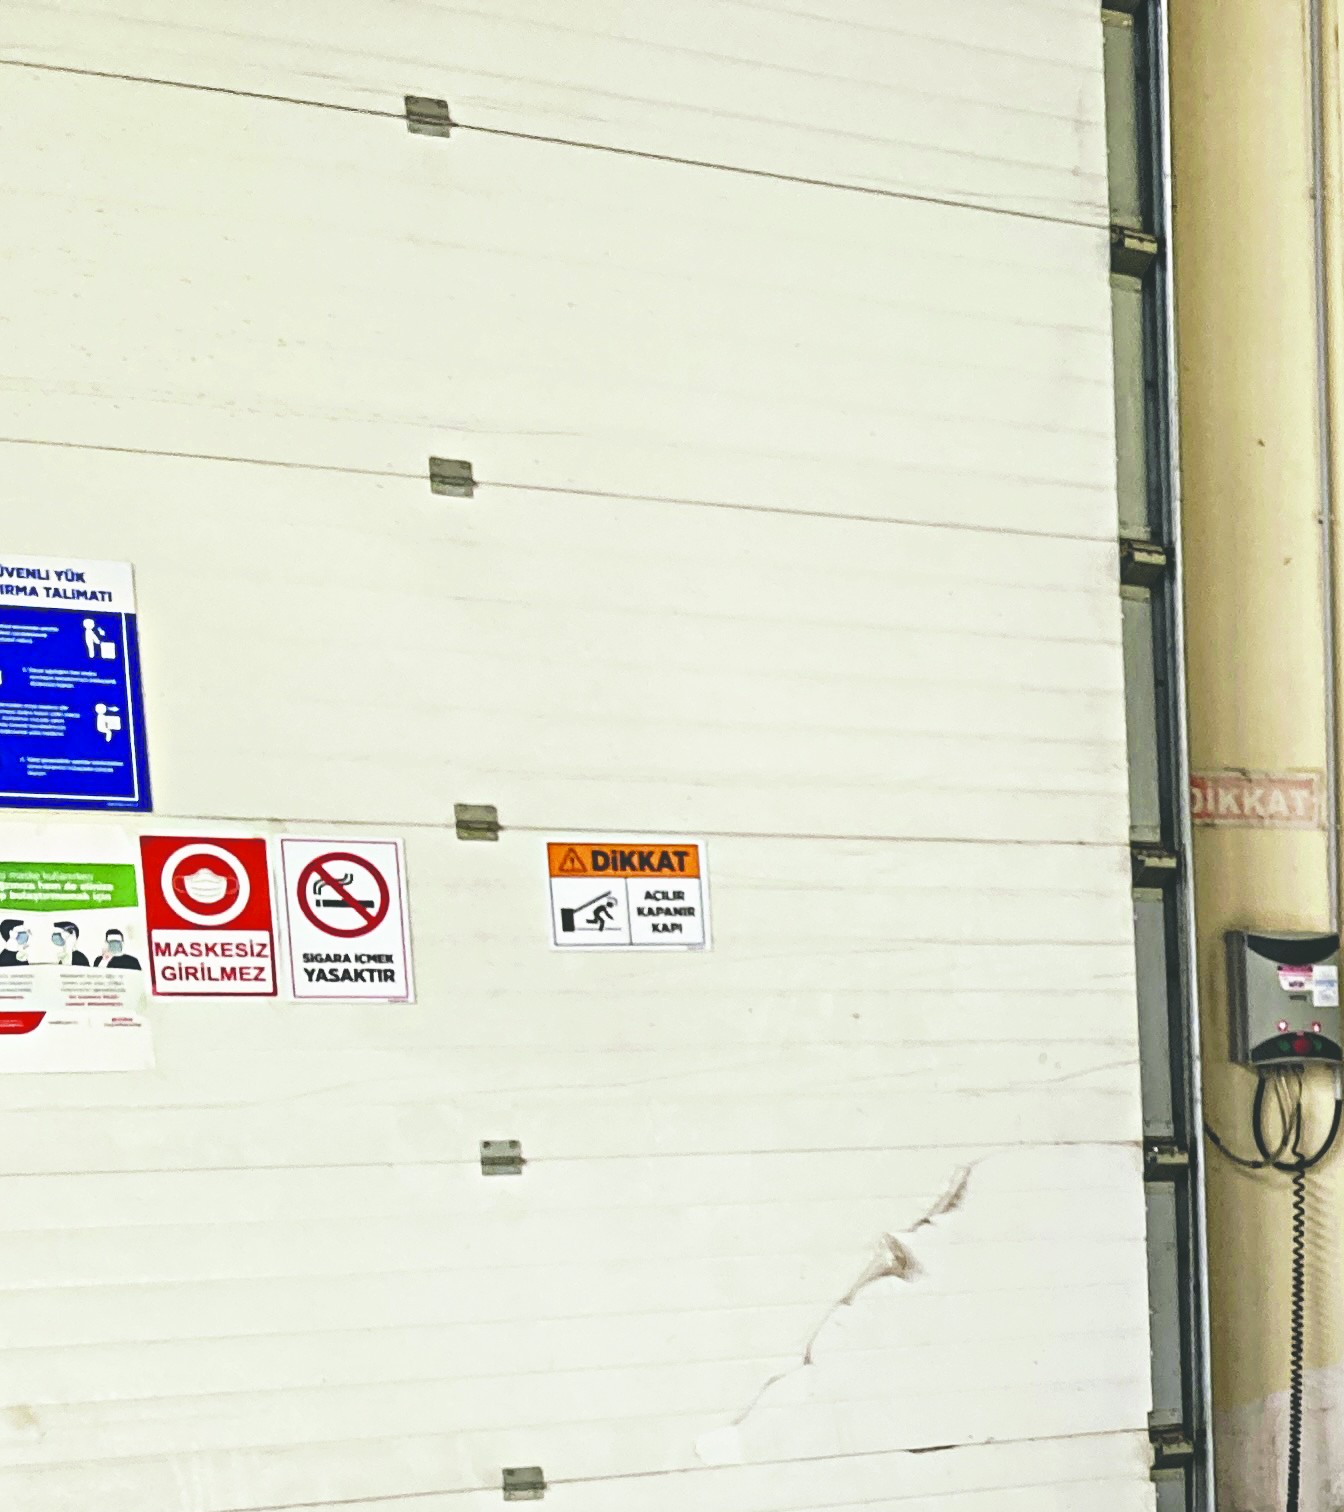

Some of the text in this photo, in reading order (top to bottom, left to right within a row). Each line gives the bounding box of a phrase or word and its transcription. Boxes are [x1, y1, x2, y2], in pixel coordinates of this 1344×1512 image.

[54, 568, 86, 584] YÜK
[637, 906, 696, 918] KAPANIR
[652, 922, 683, 934] KAPI
[154, 939, 269, 958] MASKESİZ
[161, 962, 267, 982] GİRİLMEZ
[303, 967, 396, 983] YASAKTIR
